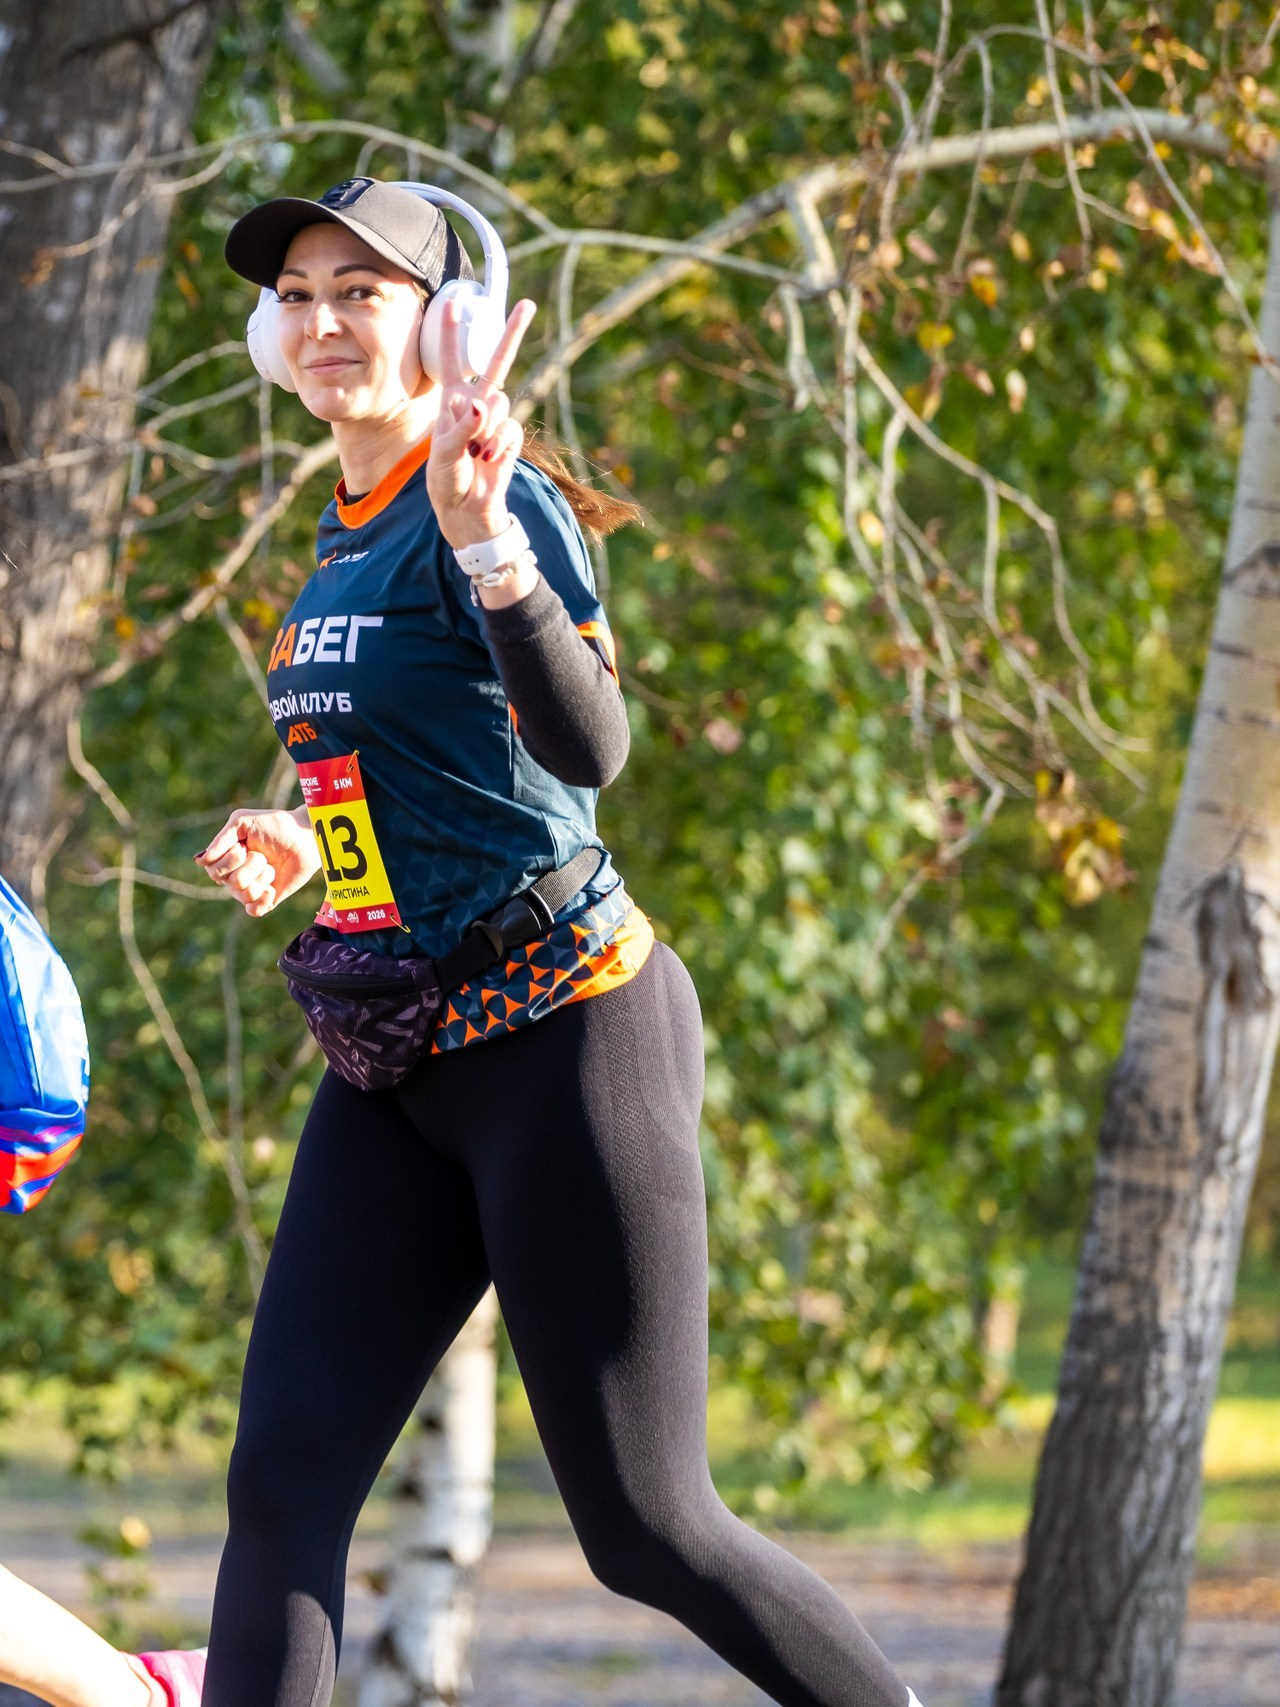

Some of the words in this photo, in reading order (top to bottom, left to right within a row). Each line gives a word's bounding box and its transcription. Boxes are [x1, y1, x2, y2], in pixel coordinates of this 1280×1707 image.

[300, 692, 353, 714] КЛУБ
[287, 722, 318, 747] АТБ
[333, 779, 339, 790] 5
[315, 815, 368, 882] 13
